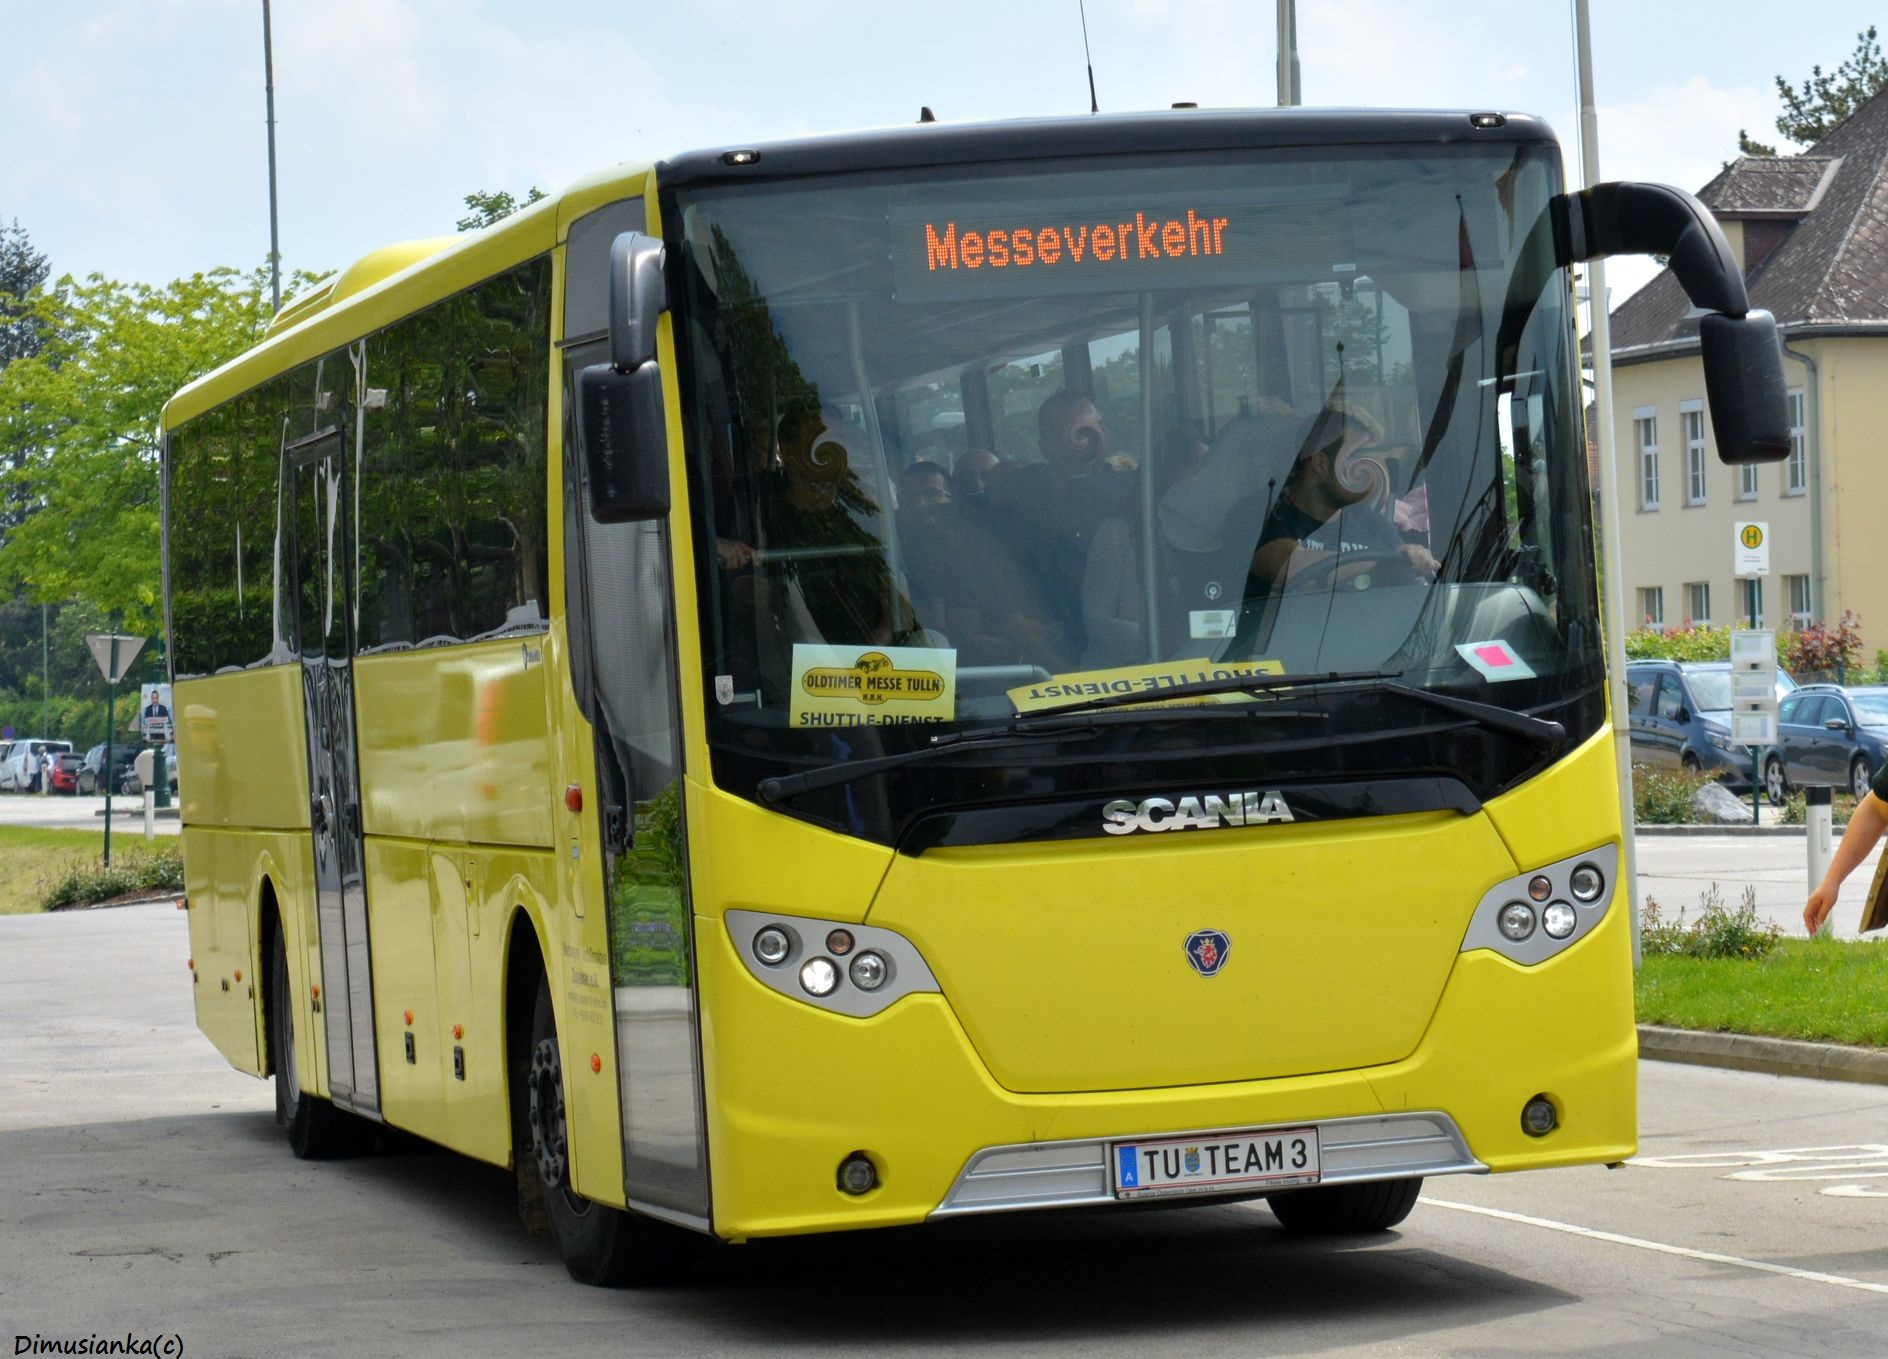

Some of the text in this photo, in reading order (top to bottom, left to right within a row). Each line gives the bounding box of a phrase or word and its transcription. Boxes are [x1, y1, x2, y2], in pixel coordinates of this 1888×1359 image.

[926, 208, 1228, 271] Messeverkehr
[1746, 529, 1758, 545] H
[806, 674, 940, 692] OLDTIMER MESSE TULLN
[1102, 790, 1295, 835] SCANIA
[1143, 1138, 1308, 1181] TU TEAM 3
[1125, 1171, 1134, 1182] A
